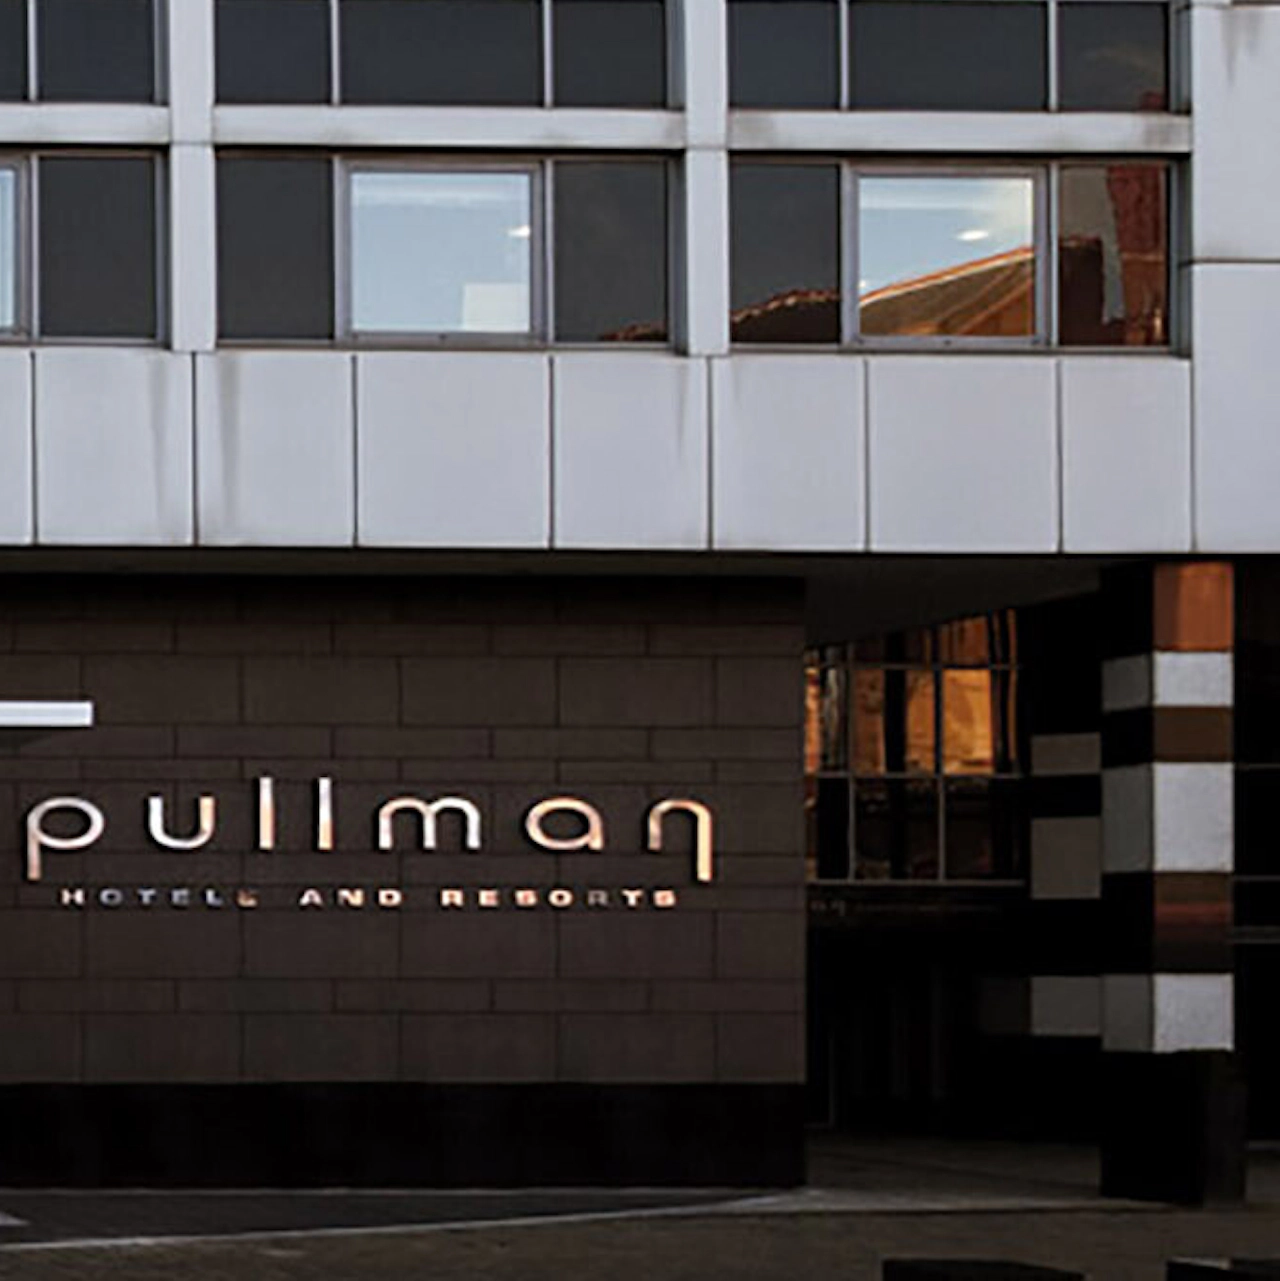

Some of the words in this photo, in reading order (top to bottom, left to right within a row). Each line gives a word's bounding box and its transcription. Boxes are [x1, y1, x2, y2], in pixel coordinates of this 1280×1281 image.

[26, 776, 714, 882] pullman
[61, 888, 258, 907] HOTELS
[299, 888, 403, 907] AND
[441, 888, 677, 907] RESORTS
